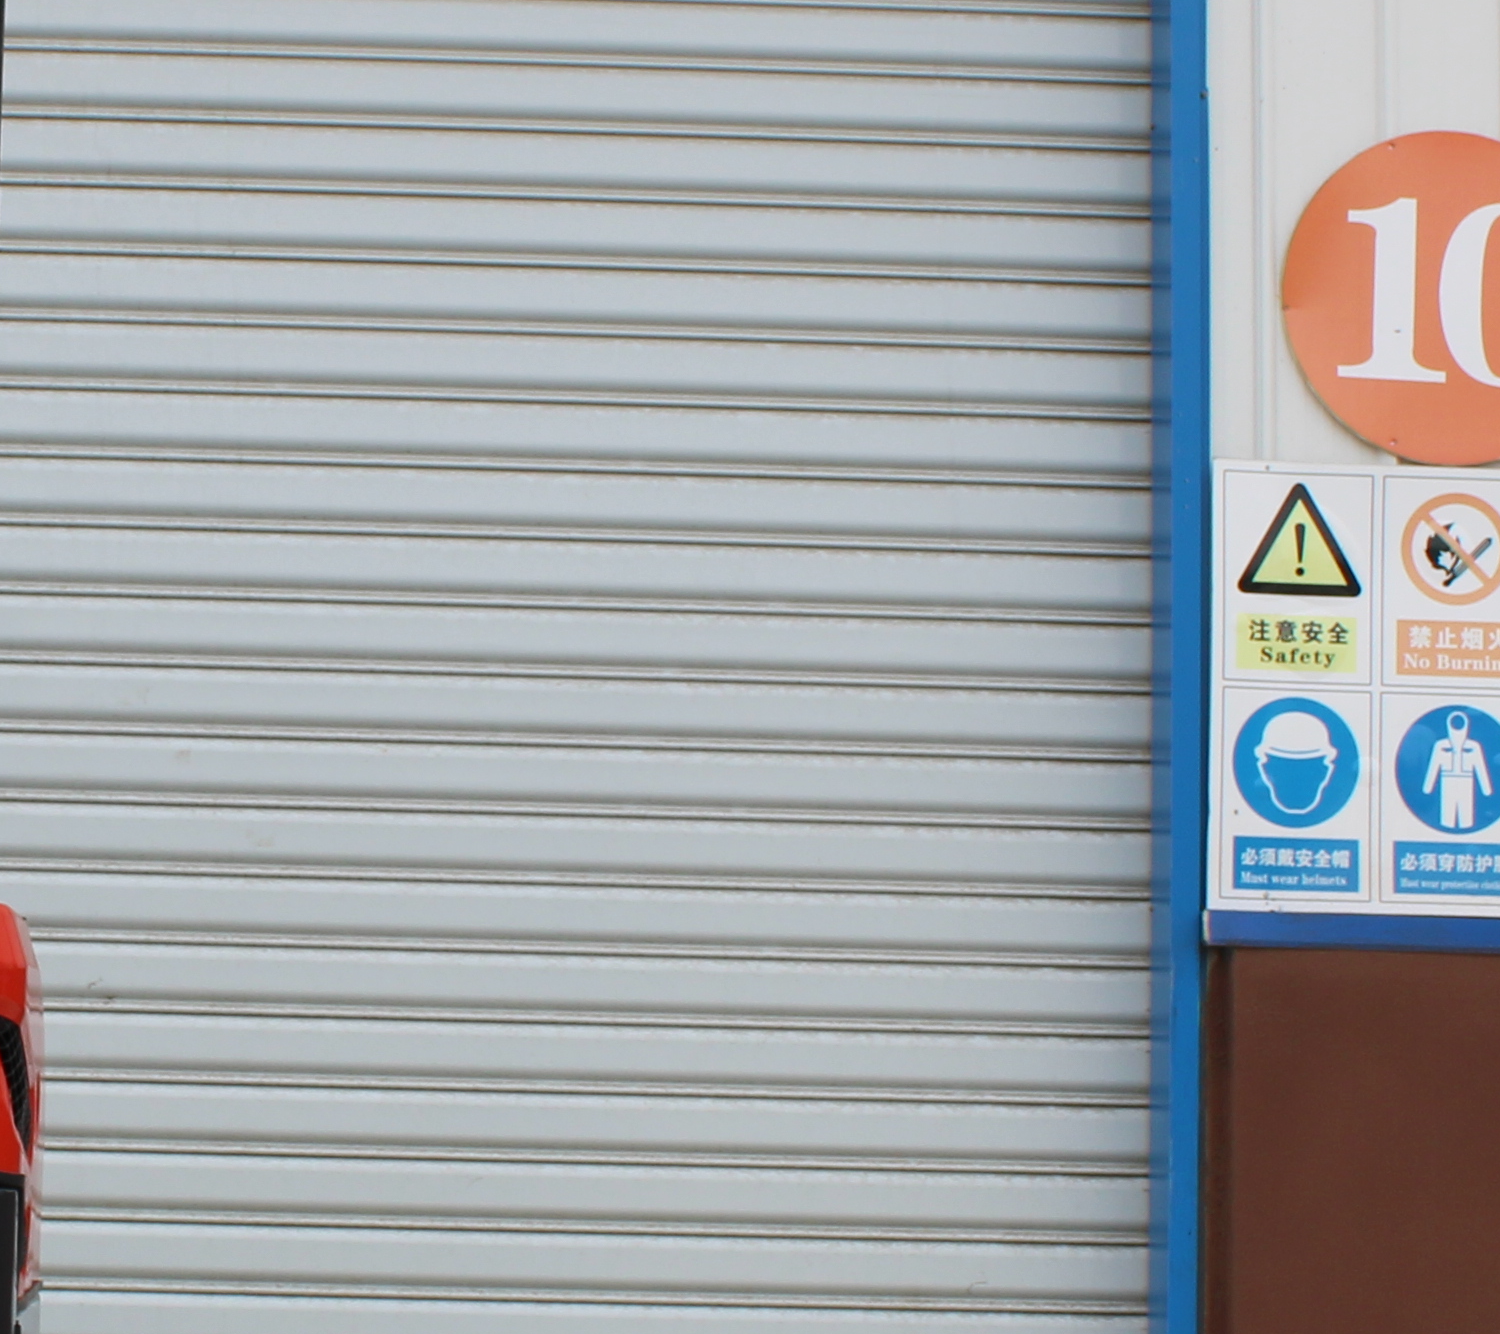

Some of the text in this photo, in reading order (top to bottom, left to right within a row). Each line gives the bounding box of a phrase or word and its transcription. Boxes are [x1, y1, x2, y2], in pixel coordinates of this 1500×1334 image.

[1249, 620, 1349, 645] 注意安全
[1260, 647, 1336, 668] Safety
[1403, 653, 1430, 669] No
[1241, 847, 1350, 868] 必须戴安全帽
[1241, 871, 1348, 886] Must wear helmets
